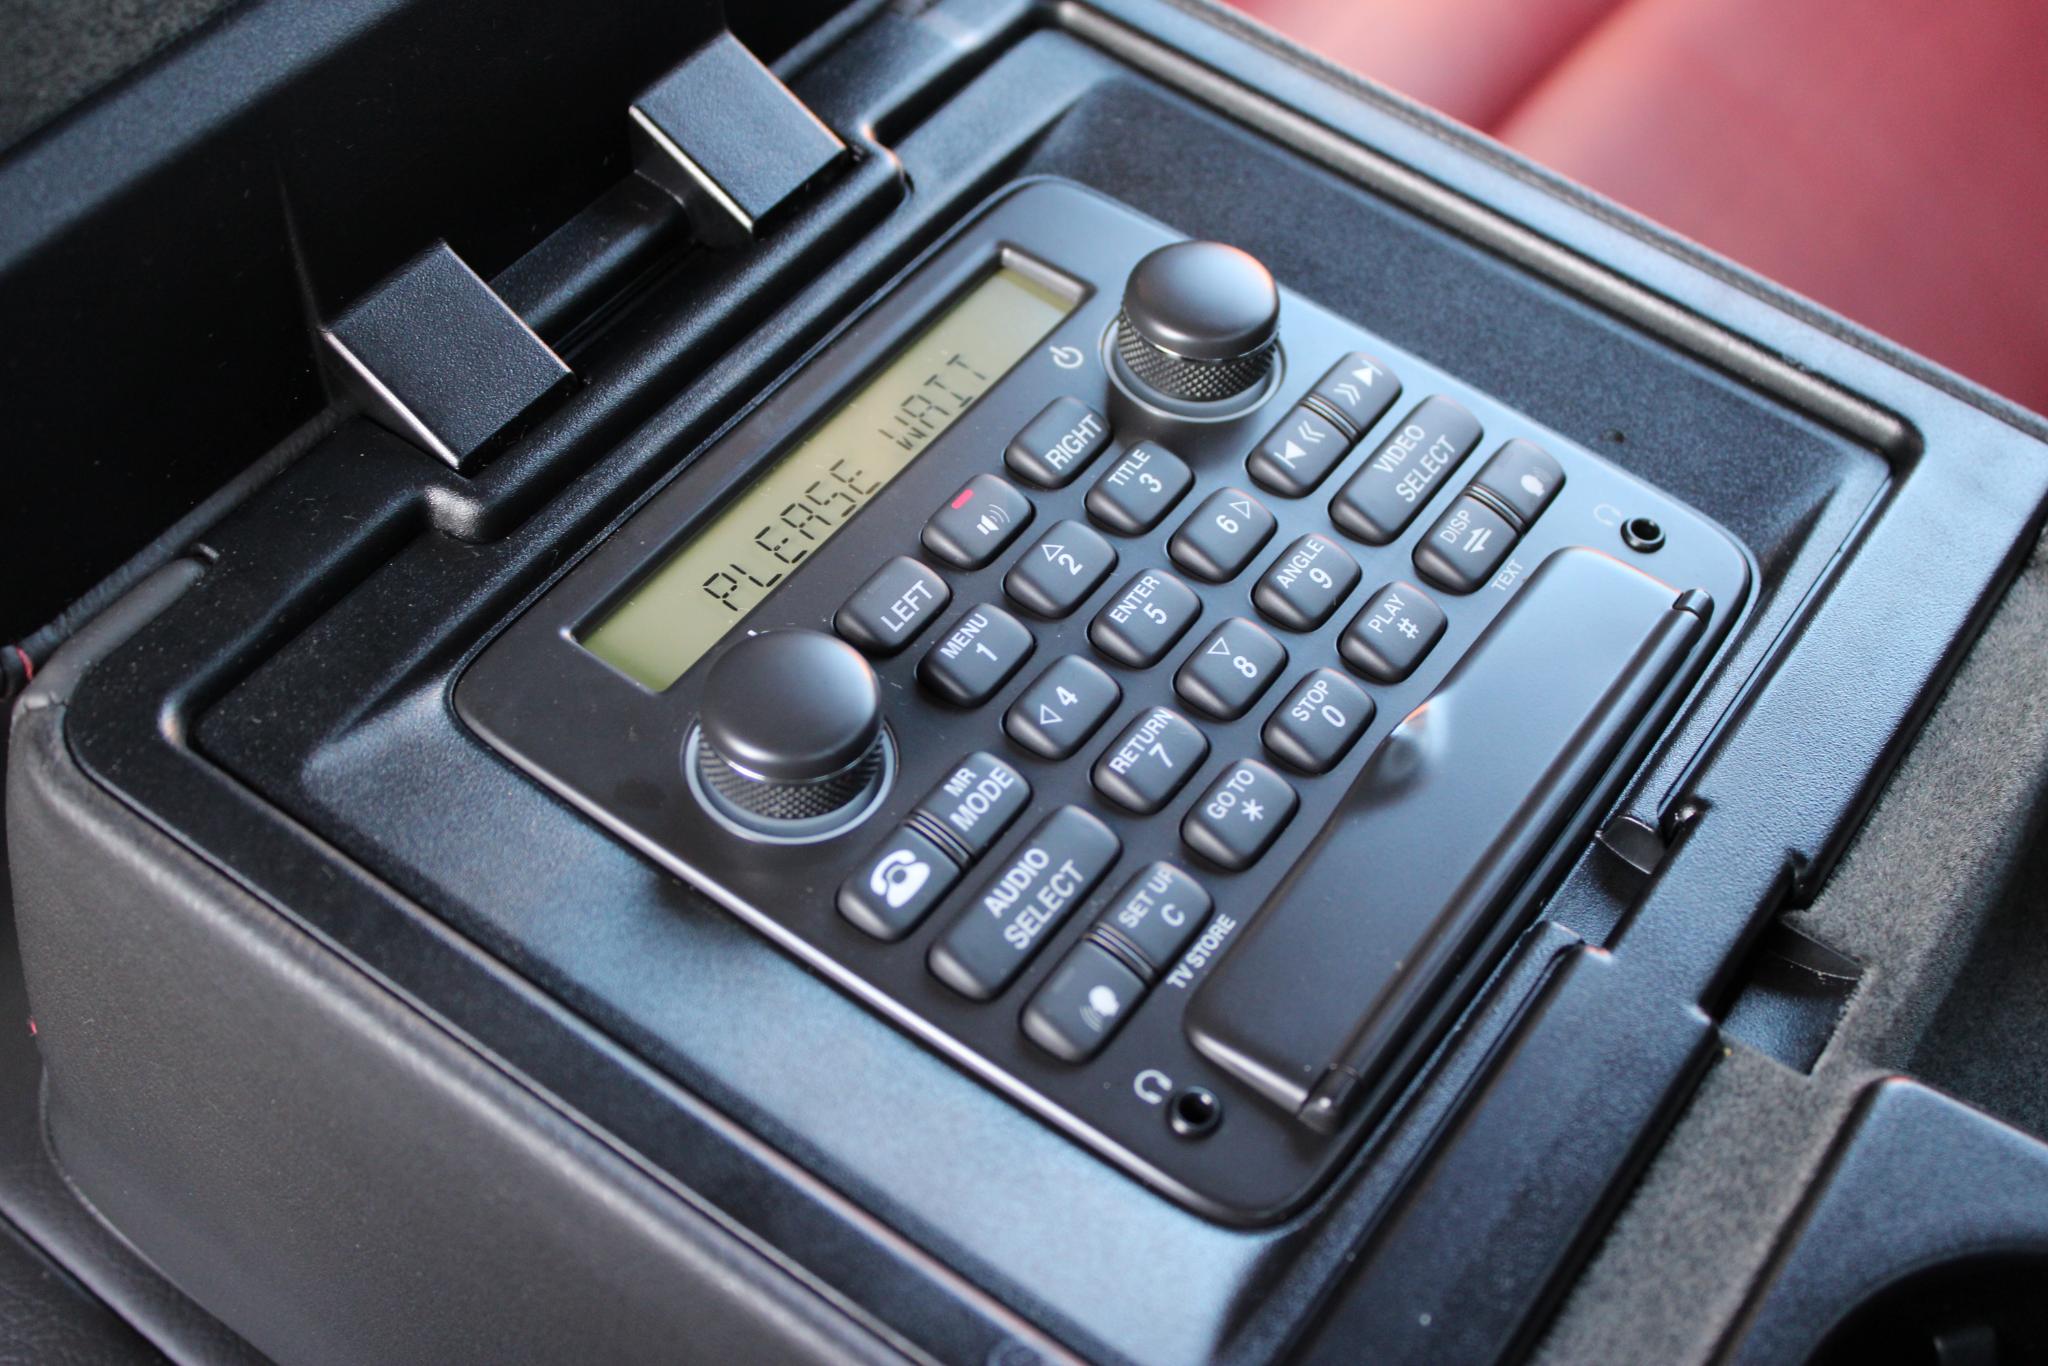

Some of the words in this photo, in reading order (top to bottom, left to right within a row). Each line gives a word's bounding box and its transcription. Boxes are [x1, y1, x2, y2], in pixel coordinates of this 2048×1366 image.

[1045, 413, 1102, 470] RIGHT
[1373, 424, 1426, 474] VIDEO
[702, 458, 882, 611] PLEASE
[877, 354, 987, 450] WAIT
[1107, 449, 1151, 488] TITLE
[1139, 473, 1163, 494] 3
[1395, 437, 1456, 502] SELECT
[1216, 515, 1239, 535] 6
[1440, 509, 1473, 545] DISP
[1058, 553, 1083, 576] 2
[1276, 538, 1325, 590] ANGLE
[1309, 568, 1333, 590] 9
[1490, 558, 1524, 592] TEXT
[880, 580, 934, 633] LEFT
[1109, 575, 1161, 625] ENTER
[1142, 602, 1168, 626] 5
[1367, 593, 1406, 634] PLAY
[939, 613, 990, 660] MENU
[975, 642, 999, 662] 1
[1233, 655, 1258, 679] 8
[1055, 686, 1079, 707] 4
[1291, 679, 1331, 723] STOP
[1321, 705, 1347, 728] 0
[1108, 708, 1174, 775] RETURN
[1148, 743, 1174, 769] 7
[943, 767, 978, 799] MR
[949, 766, 1015, 833] MODE
[983, 847, 1050, 918] AUDIO
[1003, 859, 1084, 951] SELECT
[1117, 891, 1154, 929] SET
[1161, 904, 1186, 928] C
[1166, 964, 1194, 990] TV
[1188, 914, 1237, 970] STORE
